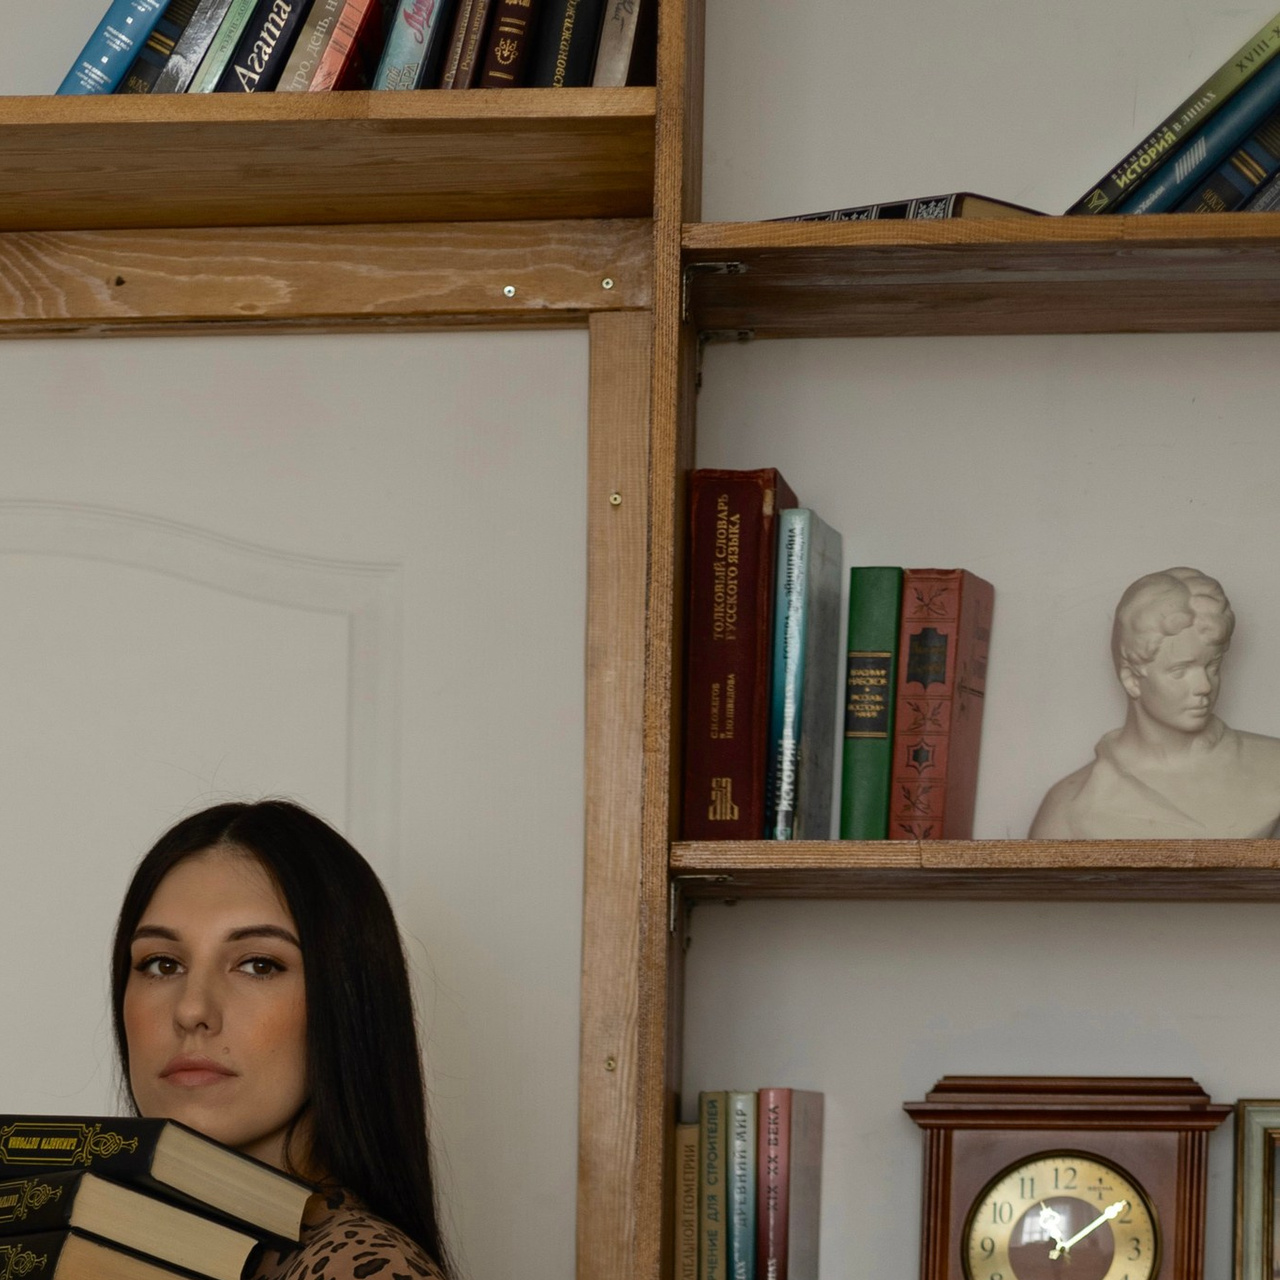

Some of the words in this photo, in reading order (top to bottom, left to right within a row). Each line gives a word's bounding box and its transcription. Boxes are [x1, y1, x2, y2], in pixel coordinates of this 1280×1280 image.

[227, 0, 292, 95] Агата
[289, 56, 314, 91] тро,
[304, 12, 333, 57] день,
[1115, 129, 1177, 189] ИСТОРИЯ
[1171, 121, 1183, 132] В
[1178, 88, 1217, 126] ЛИЦАХ
[715, 494, 728, 557] СЛОВАРЬ
[728, 513, 740, 563] ЯЗЫКА
[712, 561, 726, 639] ТОЛКОВЫЙ
[705, 1099, 718, 1185] СТРОИТЕЛЕЙ
[682, 1144, 695, 1215] ГЕОМЕТРИИ
[1020, 1177, 1036, 1200] 11
[1052, 1168, 1078, 1190] 12
[706, 1194, 718, 1221] ДЛЯ
[991, 1201, 1014, 1225] 10
[980, 1237, 995, 1260] 9
[1127, 1237, 1141, 1261] 3
